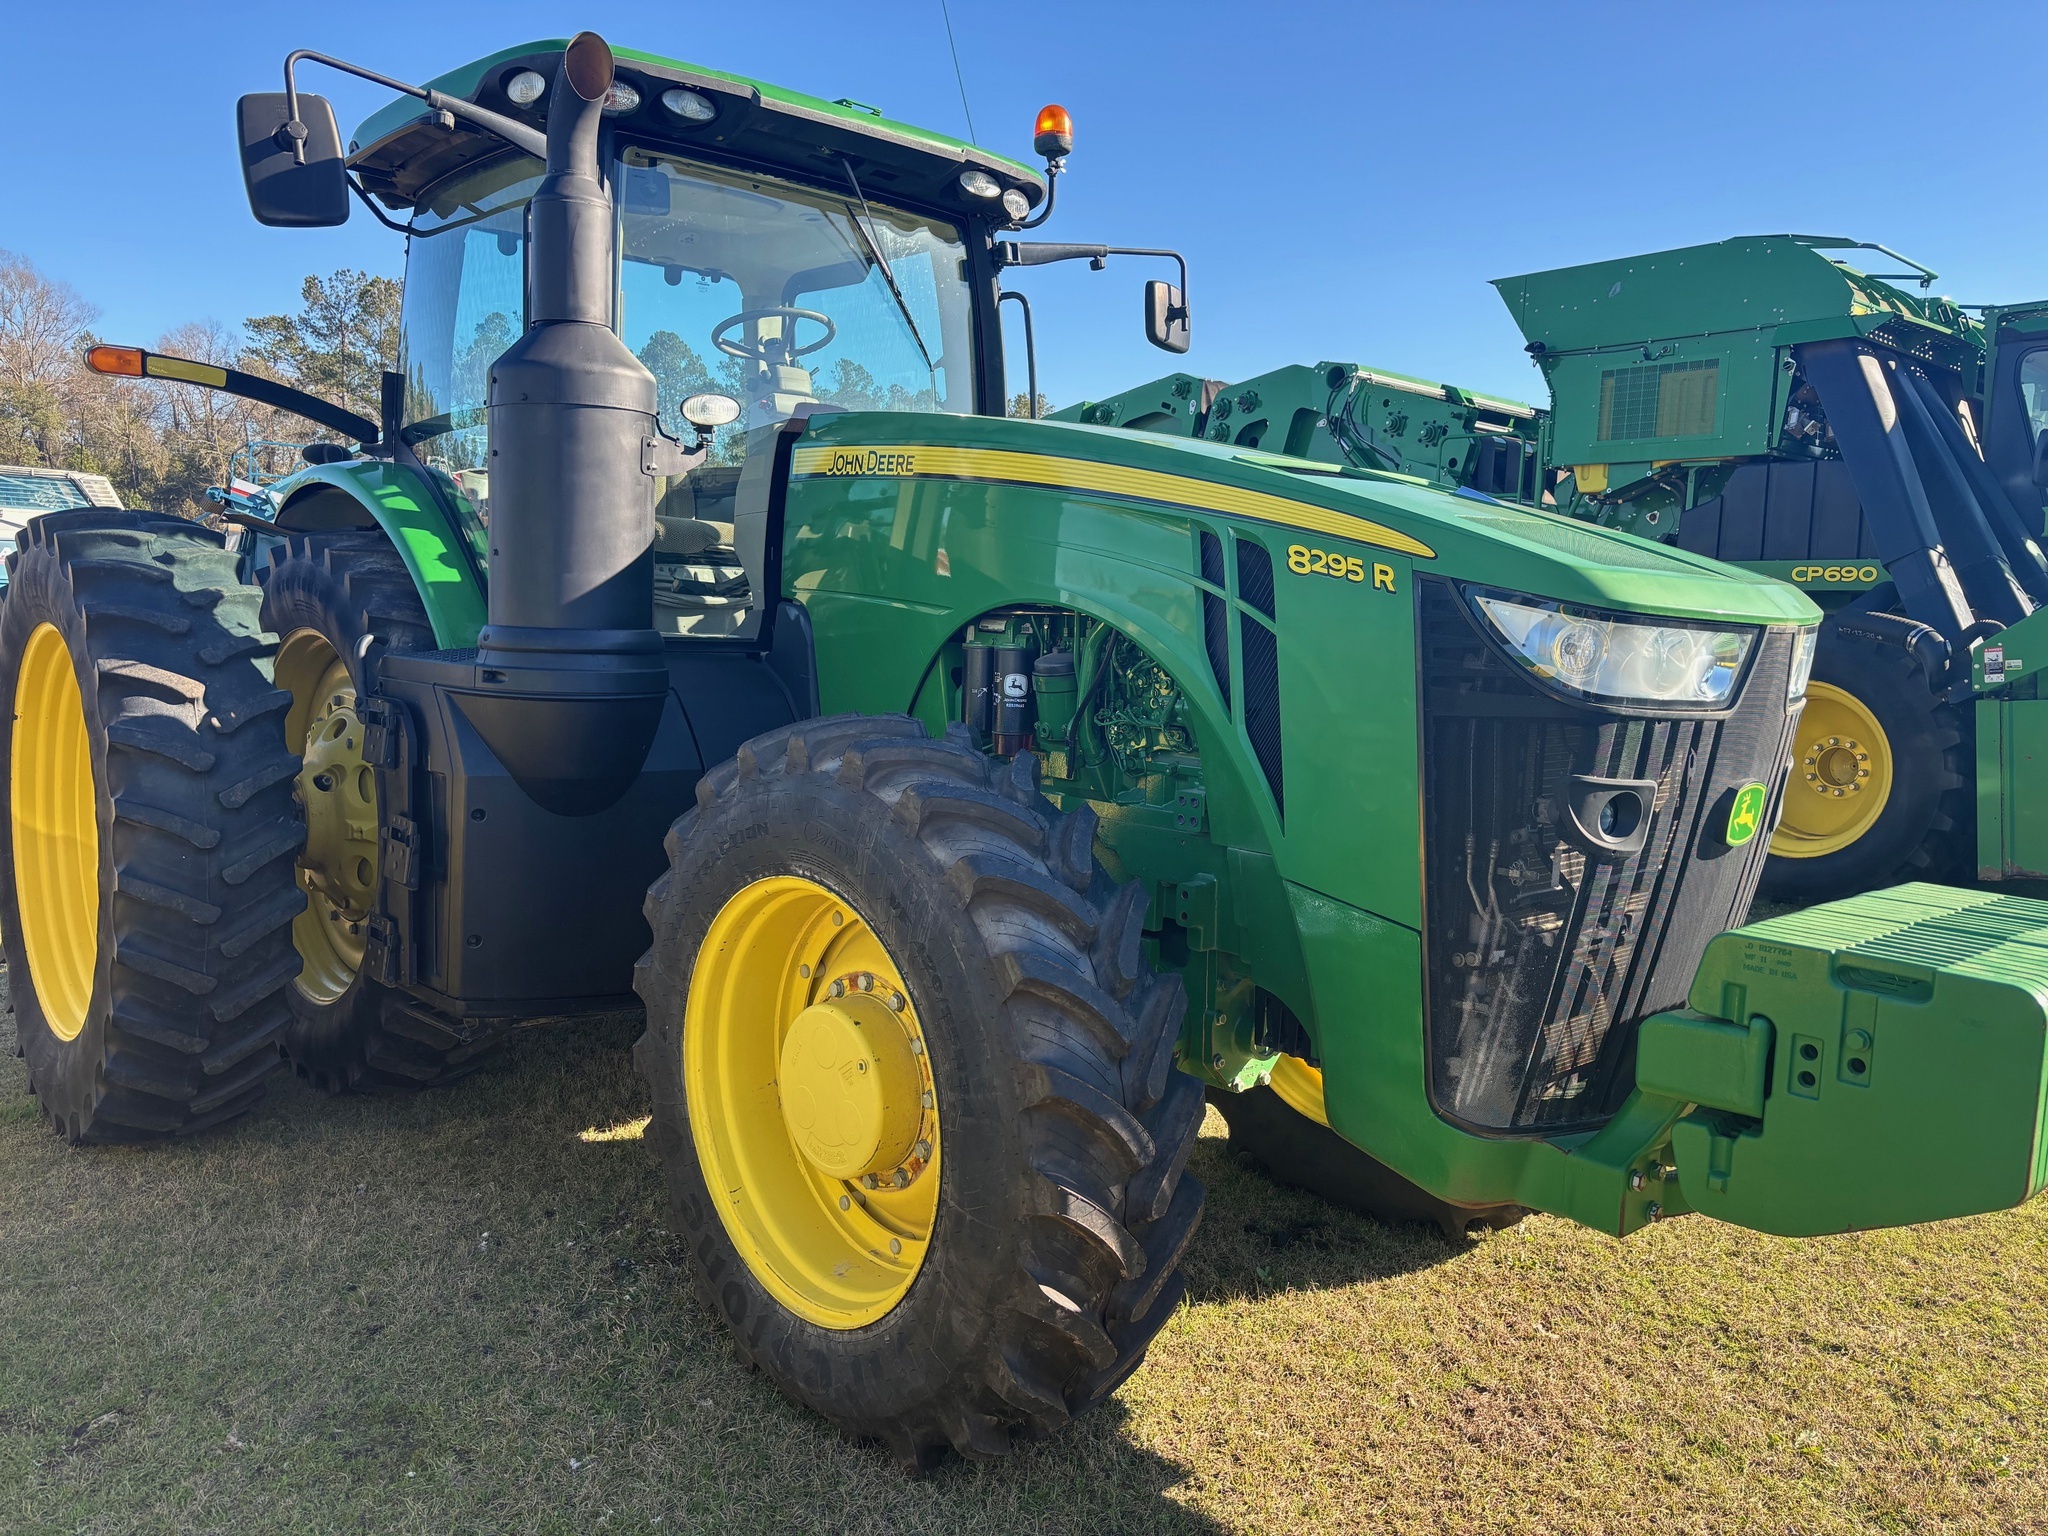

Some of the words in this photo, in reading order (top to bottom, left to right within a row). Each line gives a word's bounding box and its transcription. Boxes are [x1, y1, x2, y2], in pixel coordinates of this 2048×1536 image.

[827, 451, 864, 473] JOHN
[866, 450, 915, 473] DEERE
[1287, 544, 1365, 583] 8295
[1373, 562, 1397, 593] R
[1791, 566, 1878, 583] CP690
[1743, 963, 1765, 974] MADE
[1769, 968, 1778, 976] IN
[1781, 970, 1798, 980] USA
